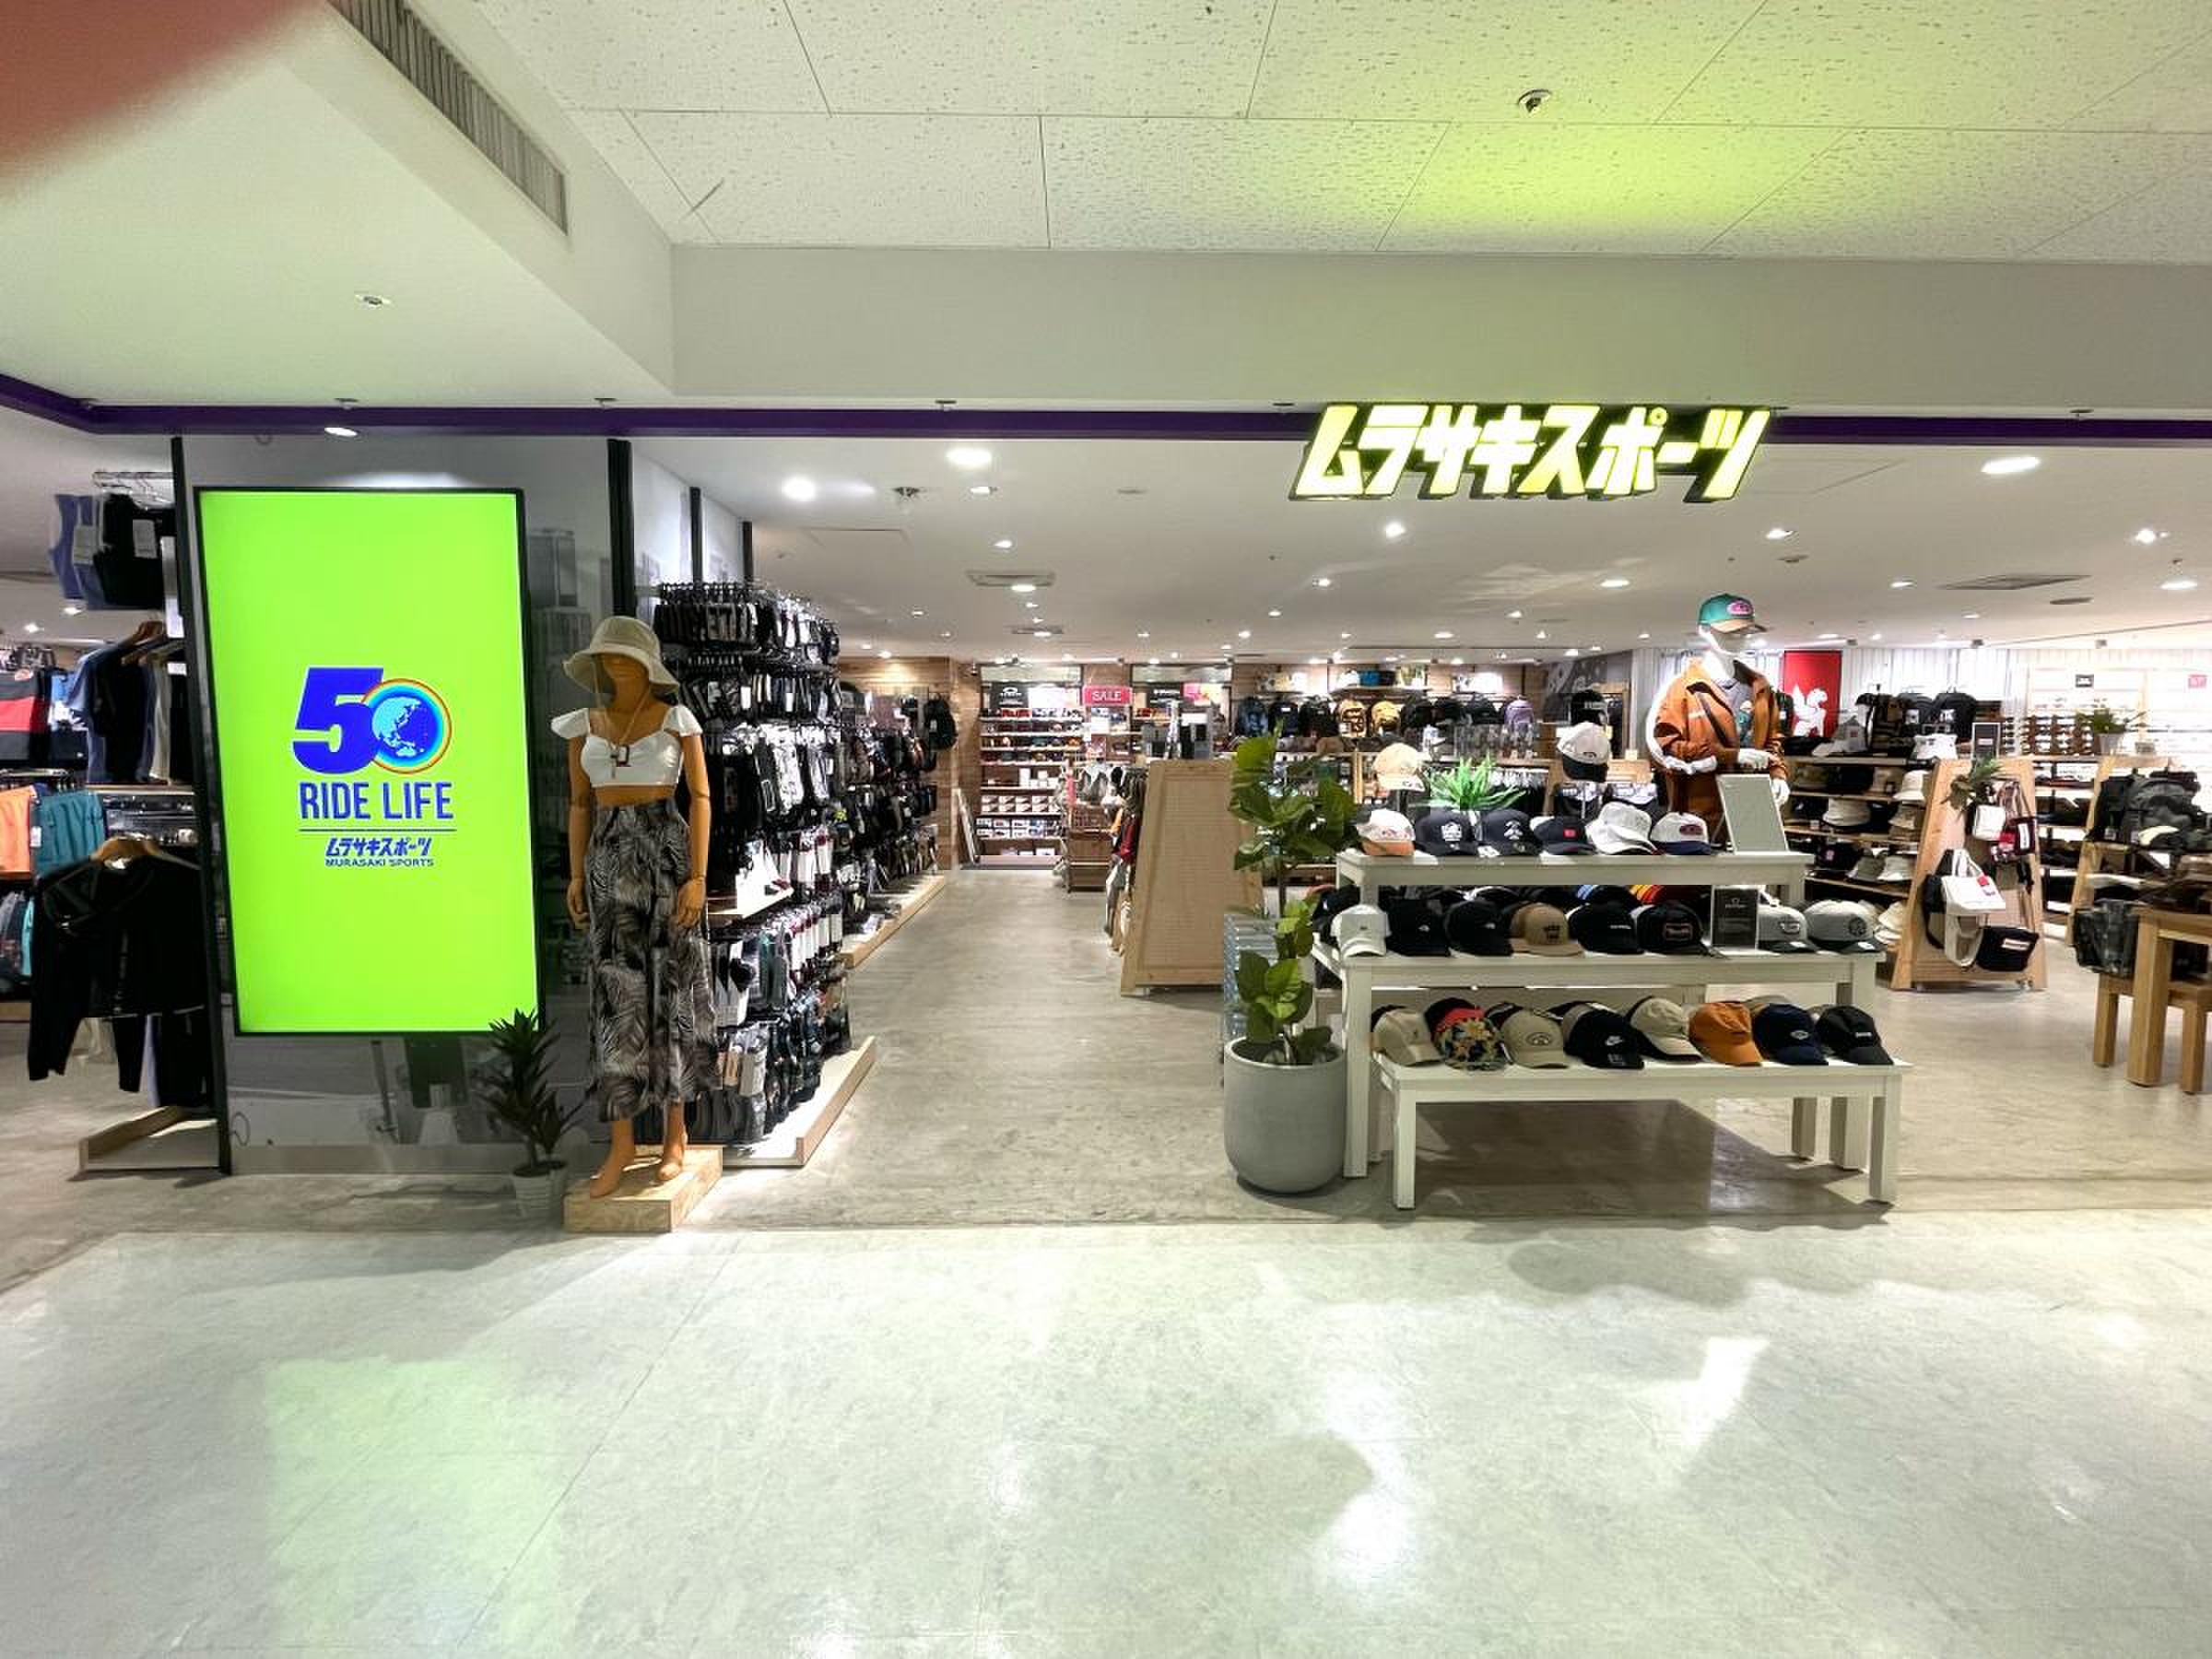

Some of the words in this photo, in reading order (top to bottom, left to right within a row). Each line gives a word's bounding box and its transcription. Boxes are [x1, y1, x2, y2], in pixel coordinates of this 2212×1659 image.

[1292, 404, 1771, 500] ムラサキスポーツ
[1091, 690, 1122, 701] SALE
[293, 666, 453, 774] 50
[299, 782, 371, 819] RIDE
[382, 782, 454, 819] LIFE
[325, 837, 432, 856] ムラサキスポーツ
[325, 858, 385, 867] MURASAKI
[390, 858, 434, 867] SPORTS
